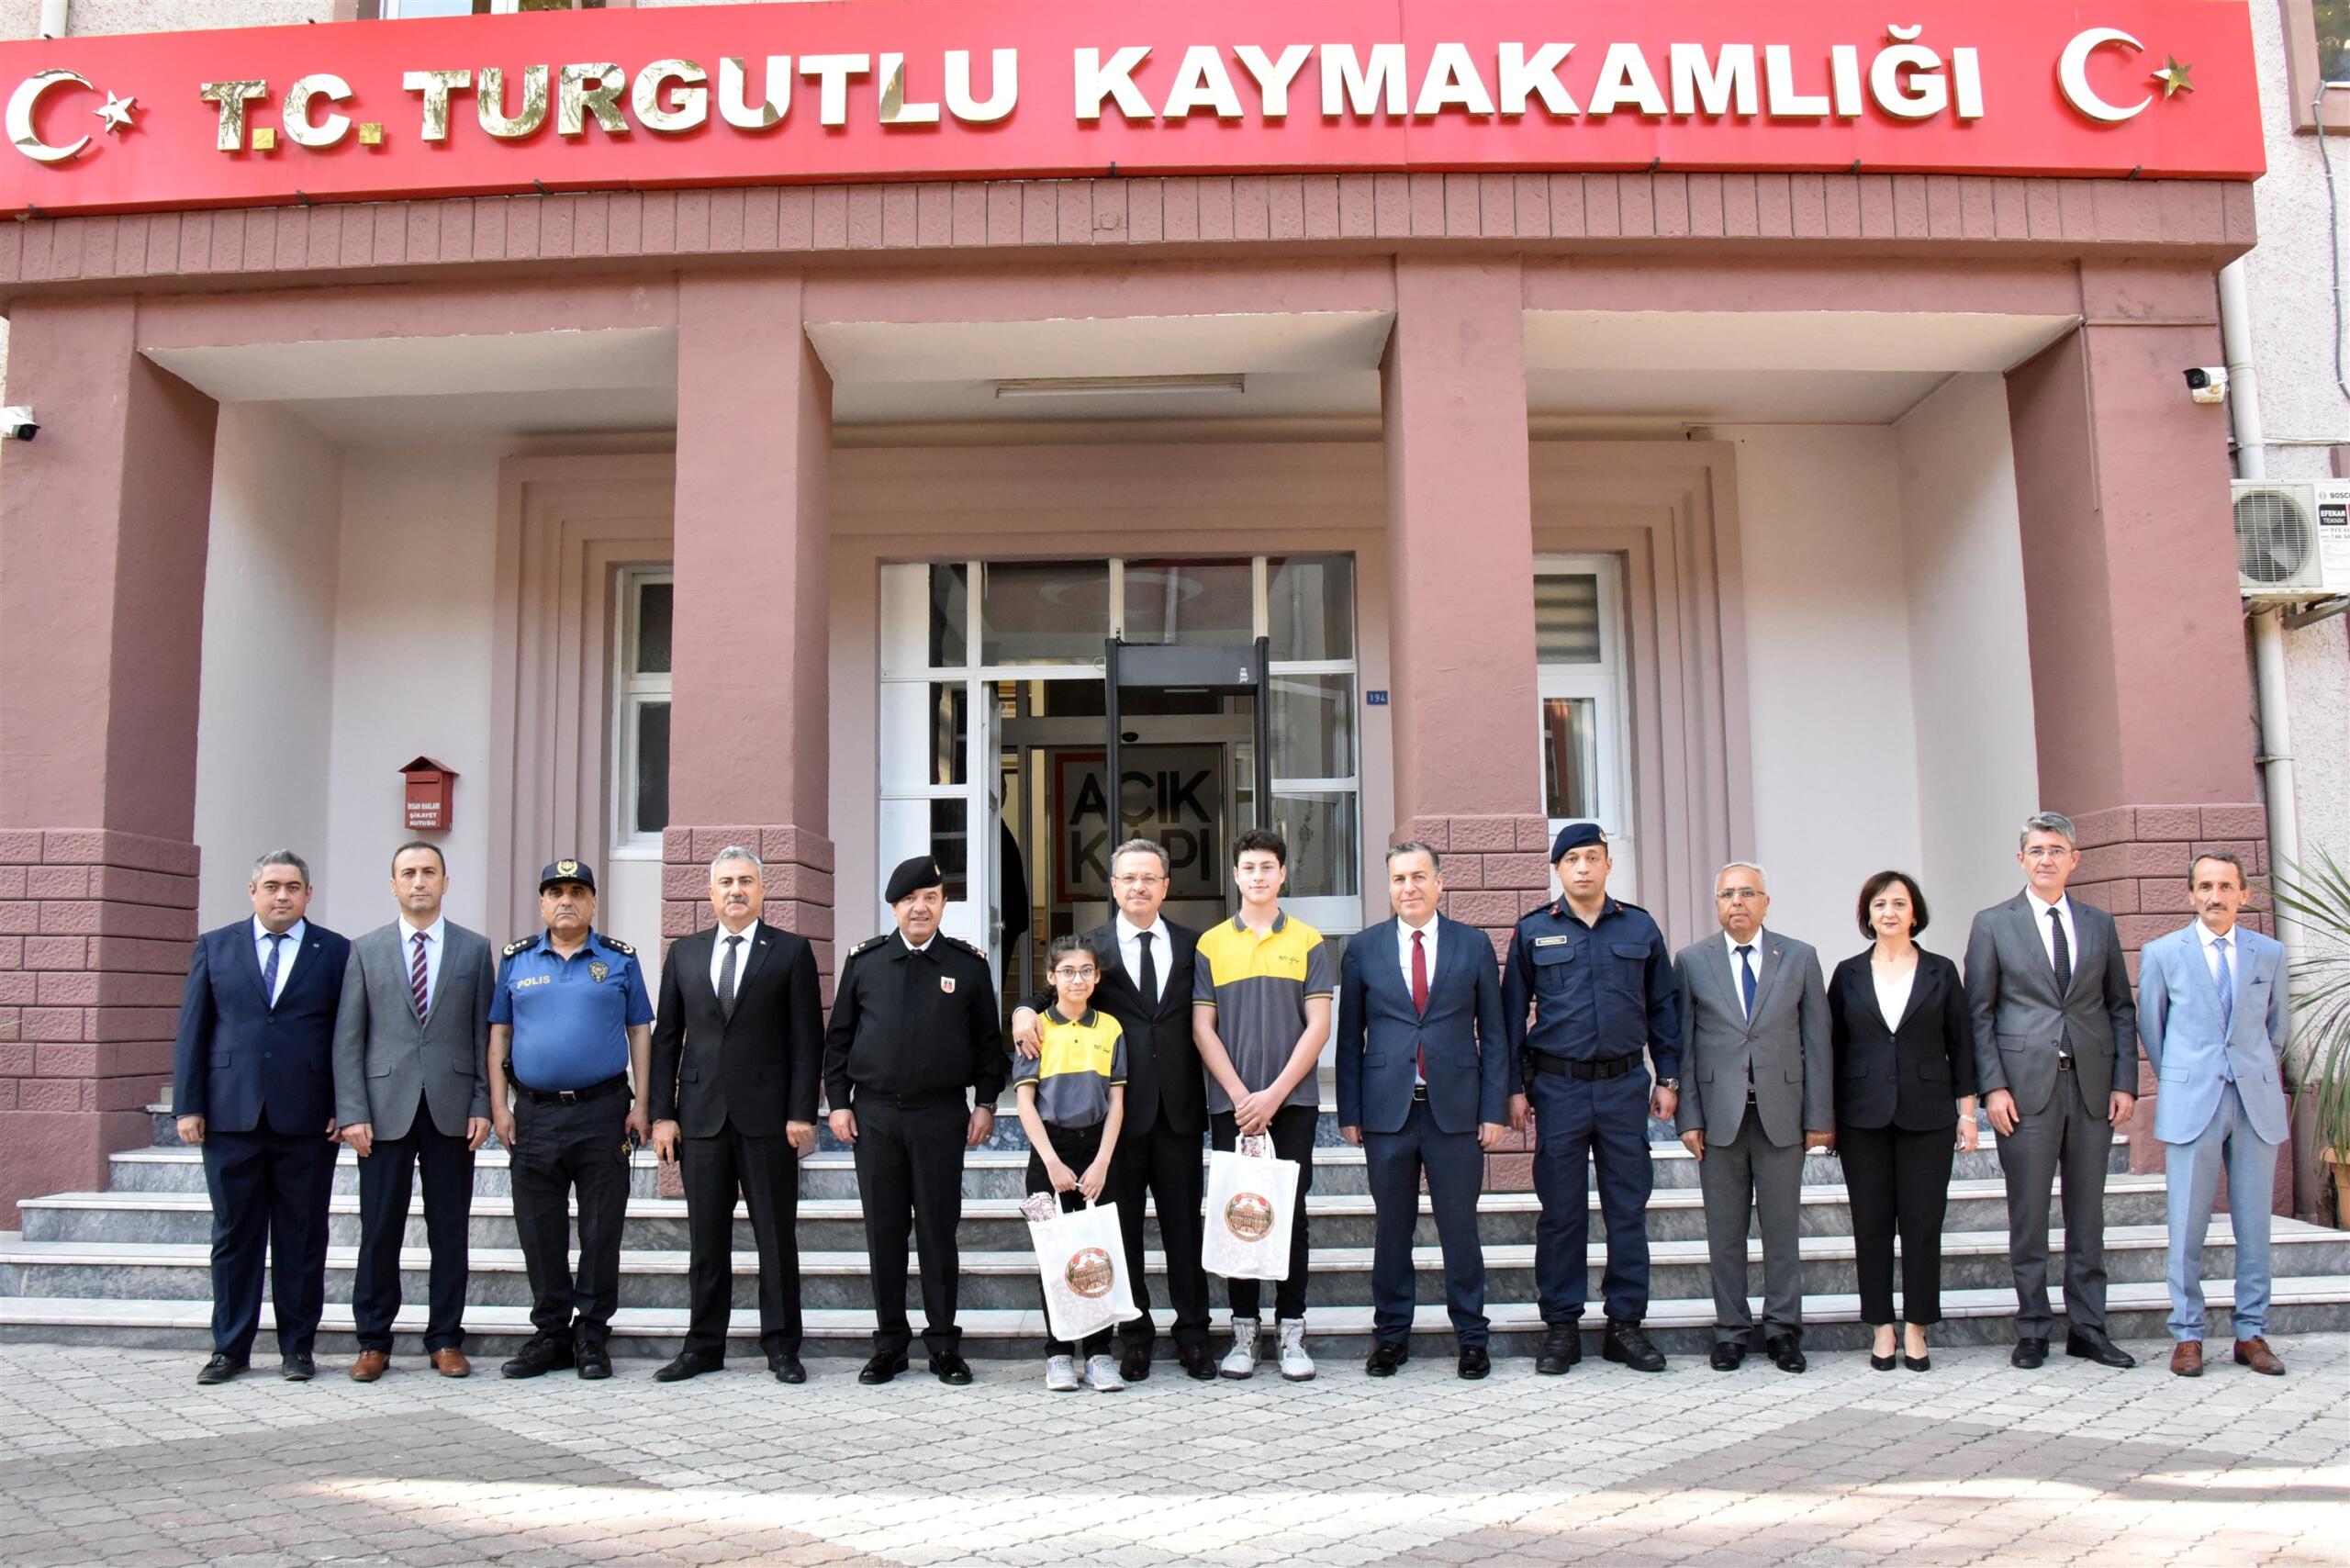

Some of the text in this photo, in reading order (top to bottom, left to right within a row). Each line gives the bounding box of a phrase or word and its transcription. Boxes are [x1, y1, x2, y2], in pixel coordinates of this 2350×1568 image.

[200, 24, 1984, 153] T.C. TURGUTLU KAYMAKAMLIĞI
[1370, 694, 1386, 702] 194
[1069, 770, 1212, 827] AÇIK
[1071, 828, 1211, 884] KPI
[516, 975, 551, 989] POLIS
